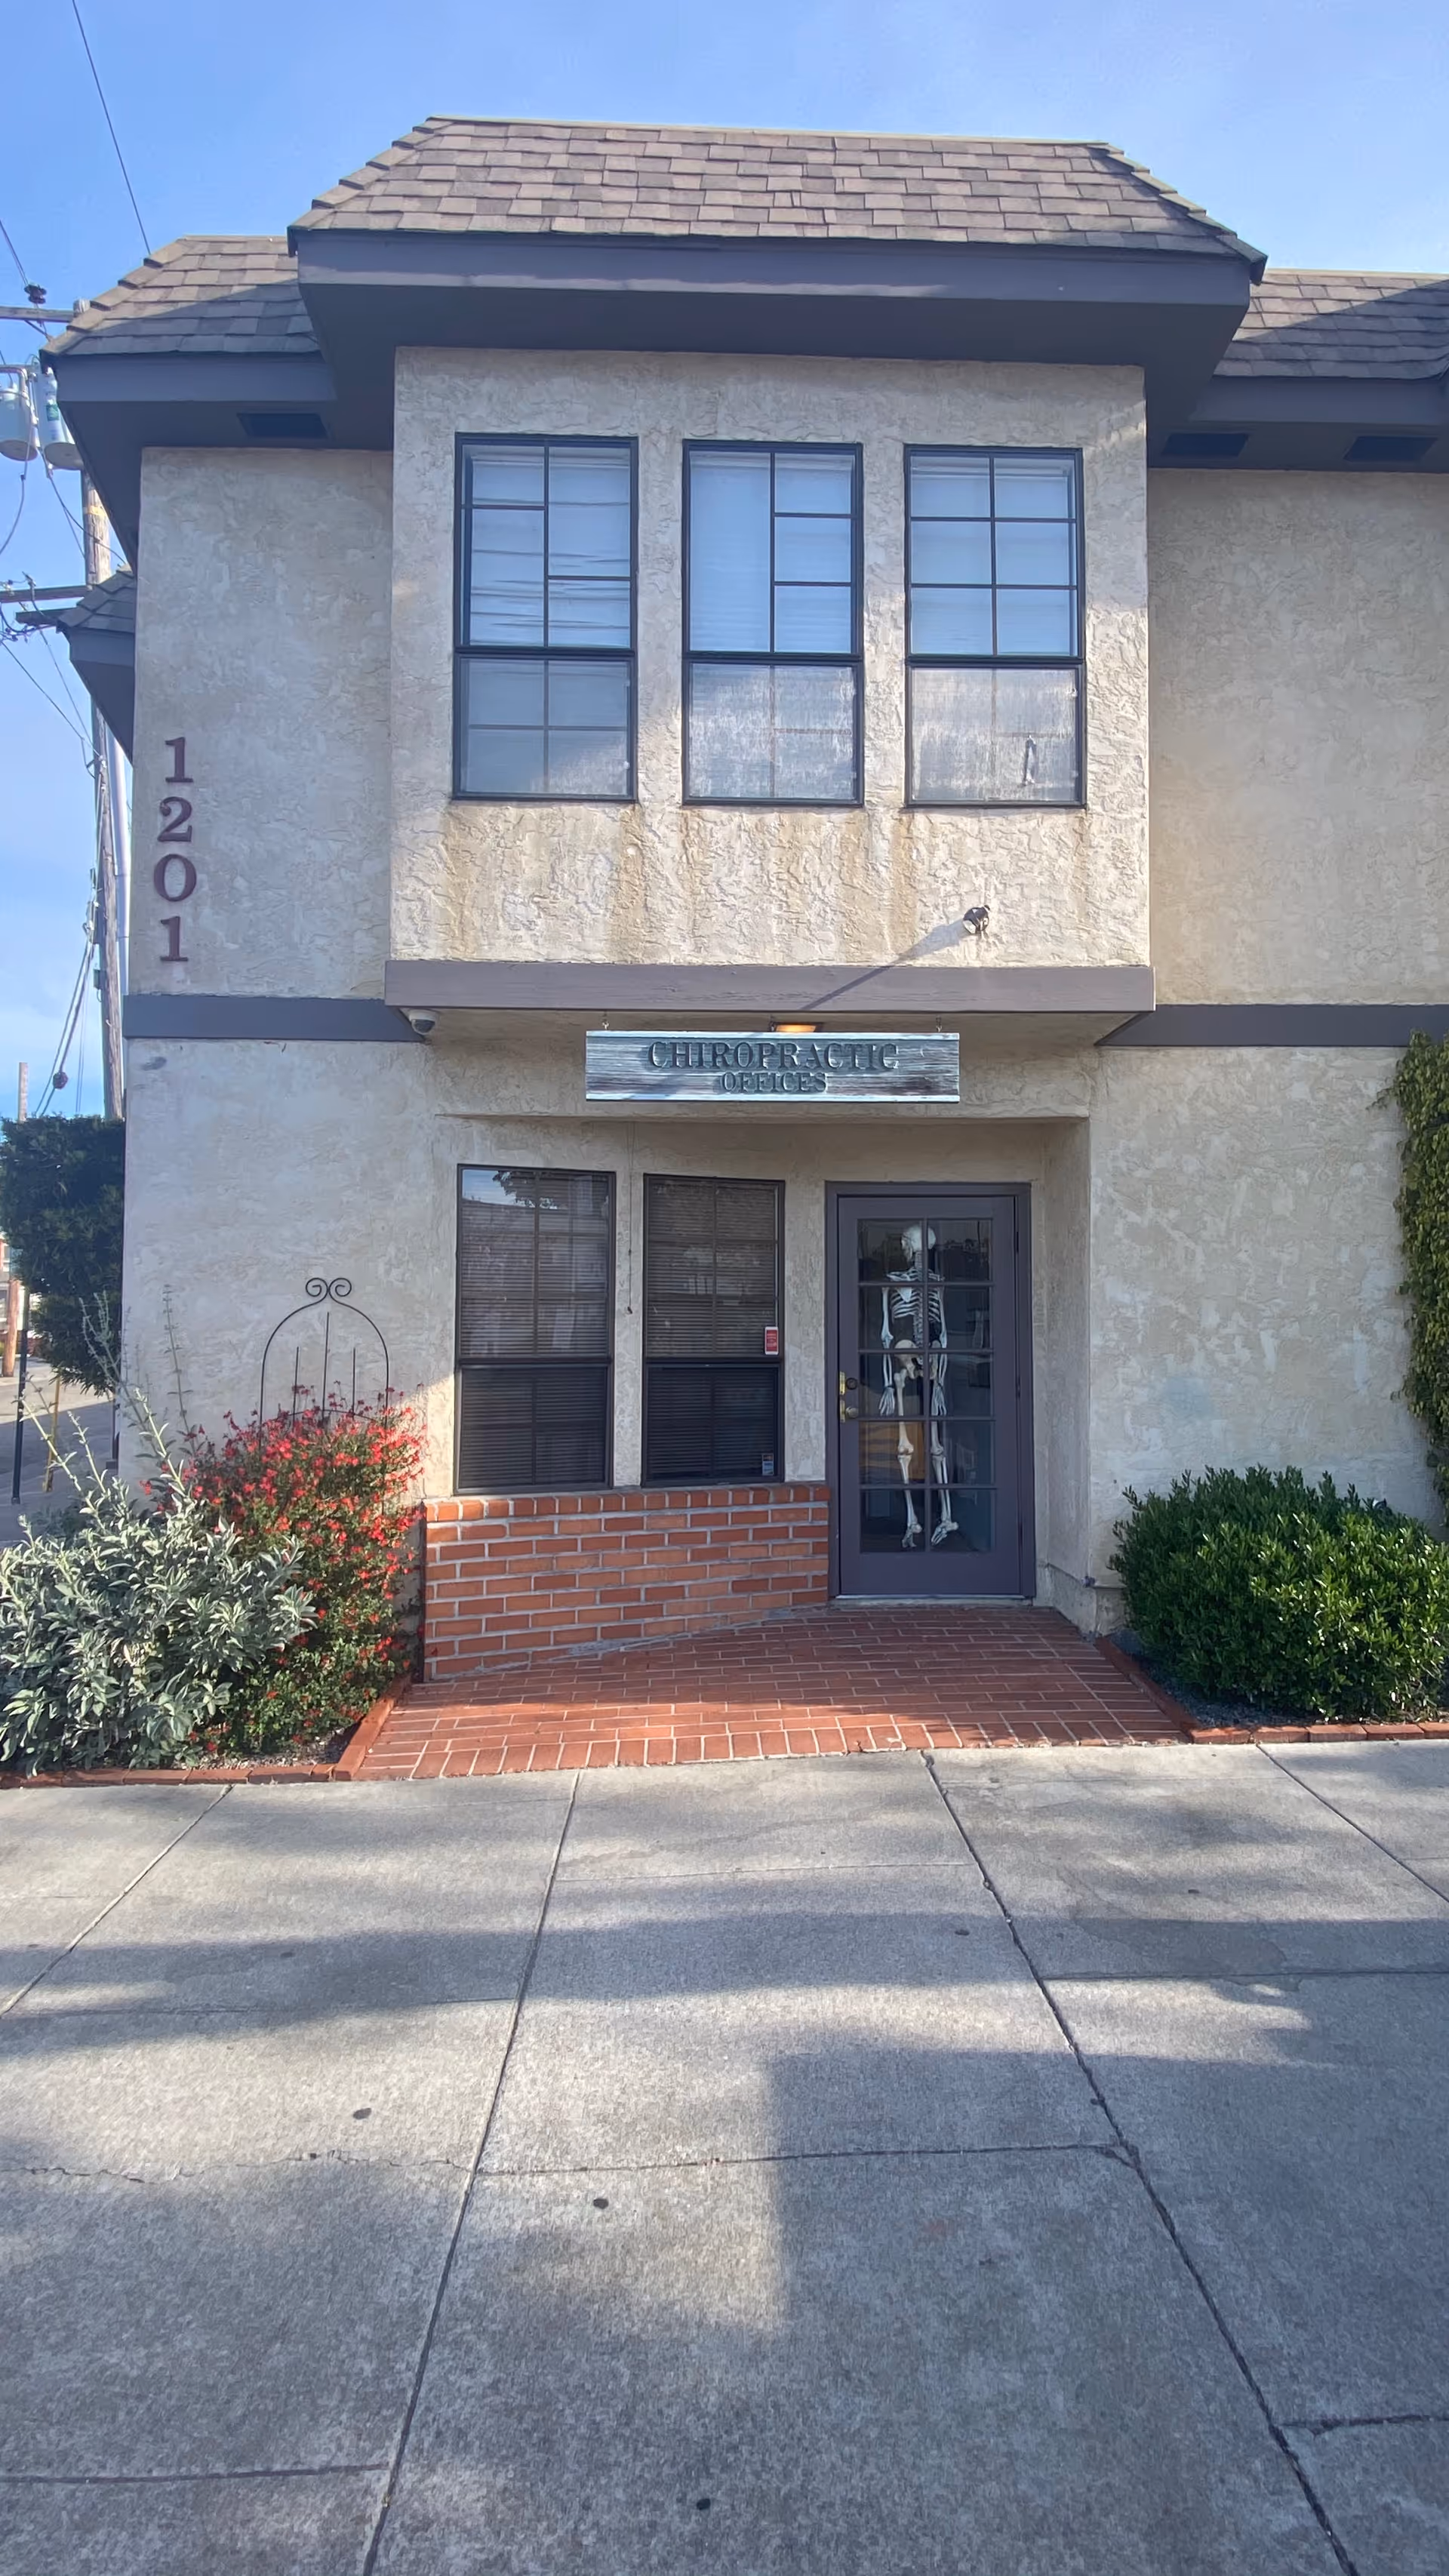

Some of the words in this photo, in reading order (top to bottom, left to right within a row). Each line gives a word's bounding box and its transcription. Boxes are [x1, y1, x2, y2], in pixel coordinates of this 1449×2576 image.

[153, 736, 197, 962] 1201
[648, 1041, 899, 1070] CHIROPRACTIC
[721, 1072, 828, 1094] OFFICES
